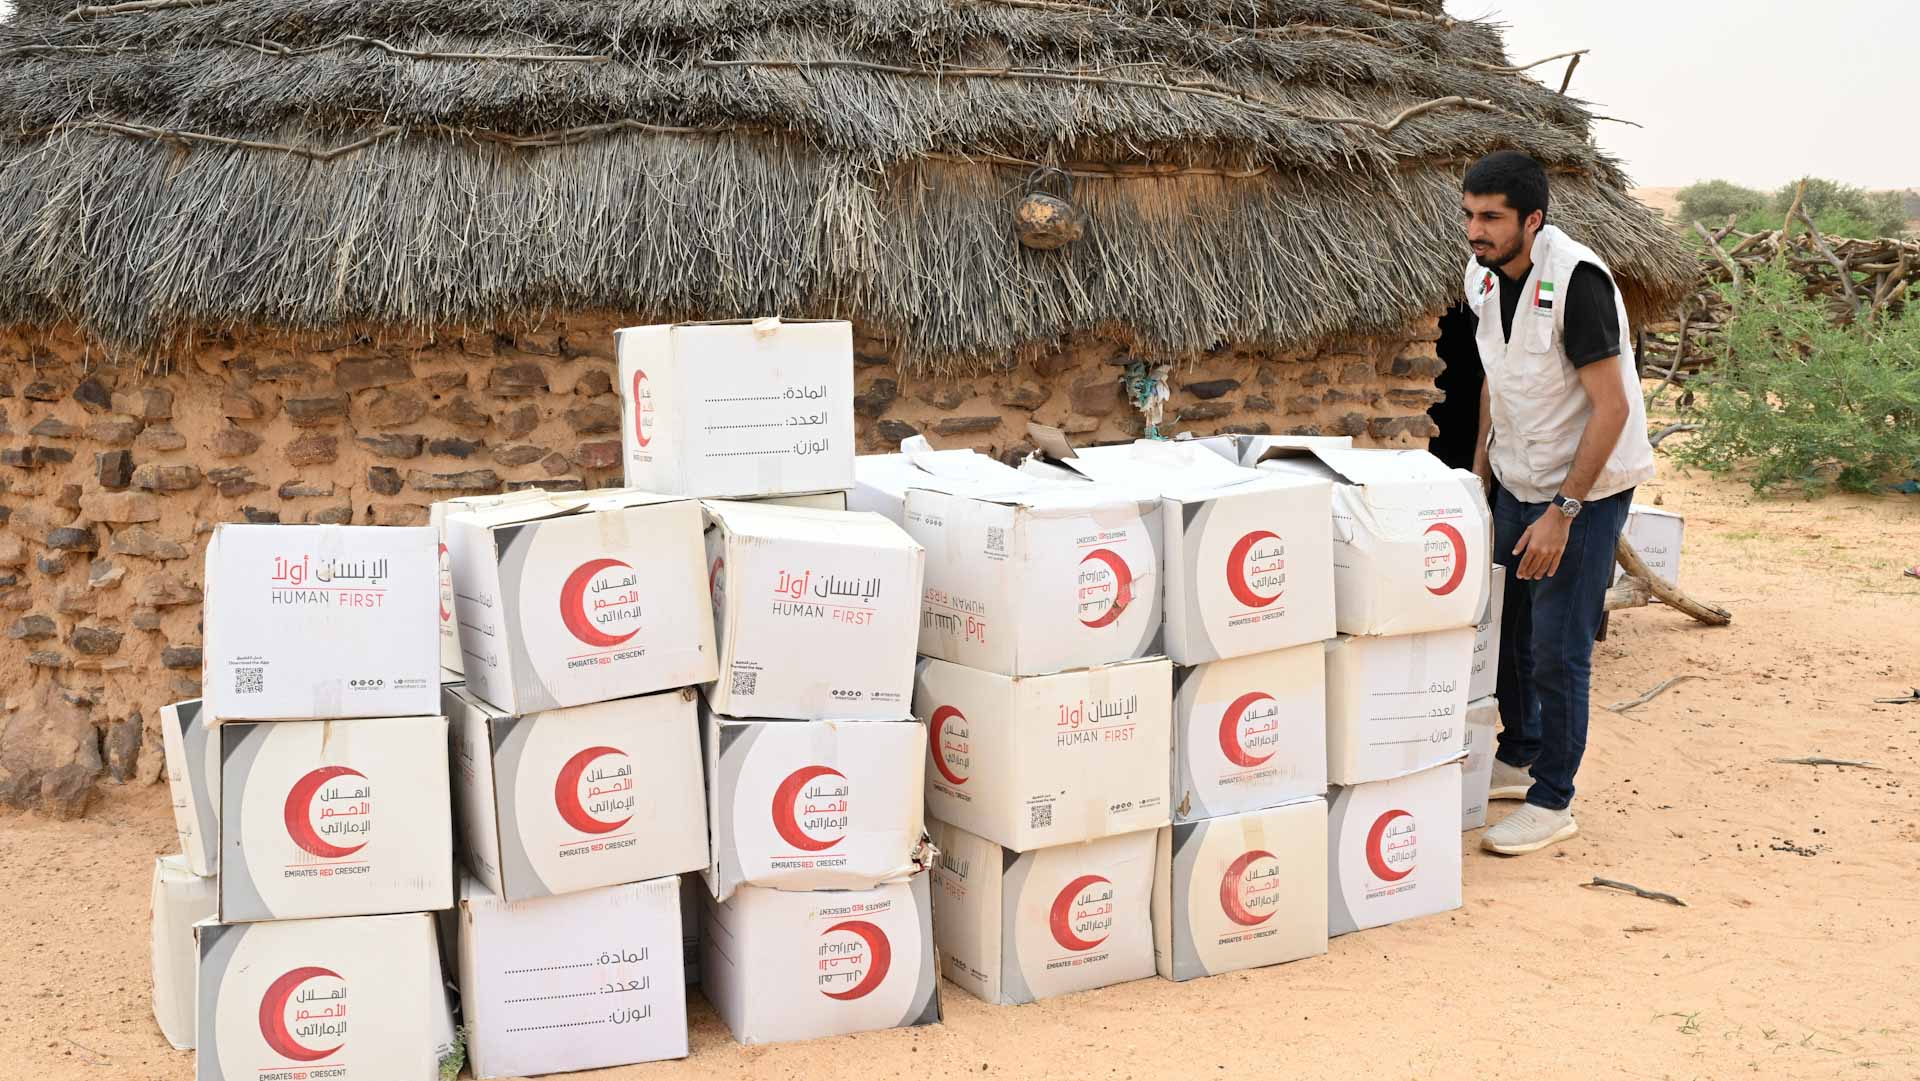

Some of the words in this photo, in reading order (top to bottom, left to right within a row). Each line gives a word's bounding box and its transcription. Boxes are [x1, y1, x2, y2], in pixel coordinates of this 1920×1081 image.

[592, 575, 637, 593] الهلال
[814, 575, 880, 603] الإنسان
[272, 591, 329, 605] HUMAN
[339, 593, 384, 608] FIRST
[594, 591, 639, 611] الأحمر
[925, 588, 948, 604] FIRST
[772, 602, 824, 618] HUMAN
[832, 610, 873, 625] FIRST
[952, 596, 984, 614] HUMAN
[568, 657, 598, 668] EMIRATES
[599, 657, 611, 665] RED
[614, 650, 645, 661] CRESCENT
[1088, 695, 1138, 722] الإنسان
[1057, 730, 1098, 747] HUMAN
[1104, 727, 1134, 742] FIRST
[586, 764, 632, 782] الهلال
[320, 786, 370, 801] الهلال
[588, 778, 633, 798] الأحمر
[805, 786, 848, 799] الهلال
[320, 802, 370, 819] الأحمر
[804, 800, 847, 815] الأحمر
[560, 847, 590, 857] EMIRATES
[604, 839, 637, 850] CRESCENT
[816, 859, 847, 867] CRESCENT
[285, 869, 318, 878] EMIRATES
[335, 866, 370, 875] CRESCENT
[1077, 890, 1113, 906] الهلال
[1076, 903, 1113, 920] الأحمر
[296, 987, 347, 1003] الهلال
[296, 1004, 346, 1021] الأحمر
[259, 1072, 292, 1081] EMIRATES
[293, 1072, 307, 1080] RED
[310, 1069, 346, 1078] CRESCENT
